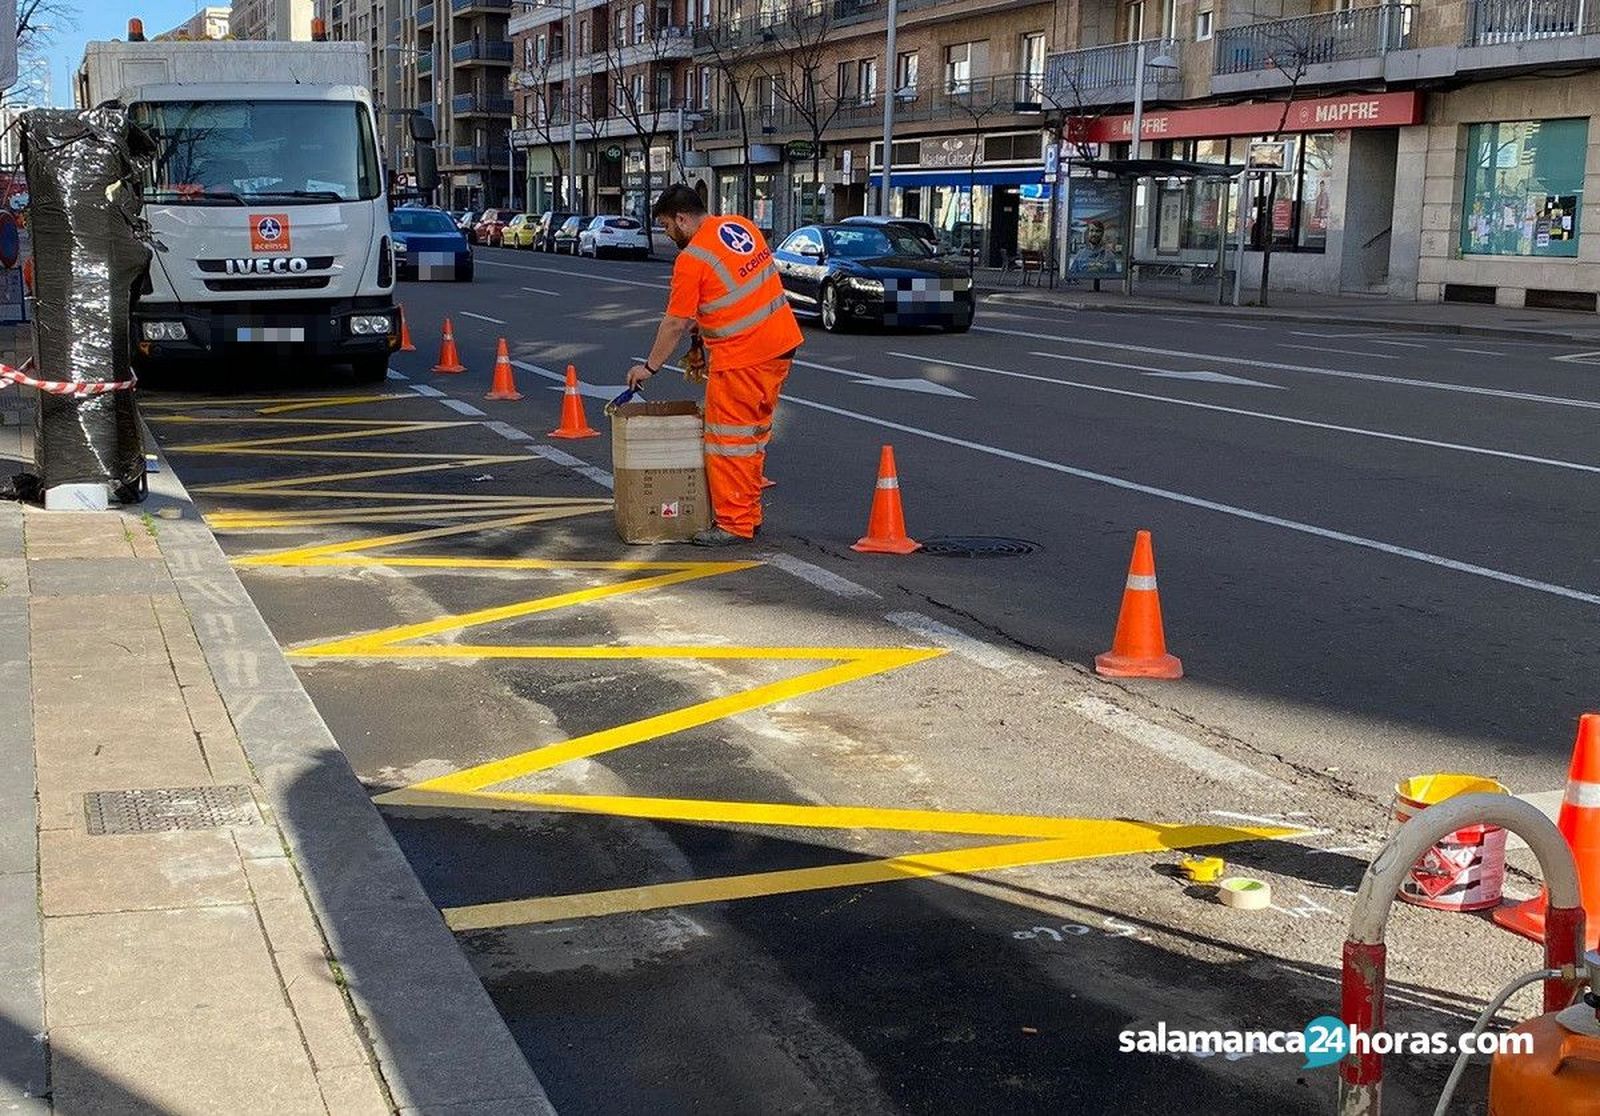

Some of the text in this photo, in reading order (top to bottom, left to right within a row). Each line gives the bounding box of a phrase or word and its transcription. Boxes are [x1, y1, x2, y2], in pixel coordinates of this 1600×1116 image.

[1315, 101, 1380, 122] MAPFRE
[1122, 117, 1168, 135] MPFRE
[226, 257, 308, 275] IVECO
